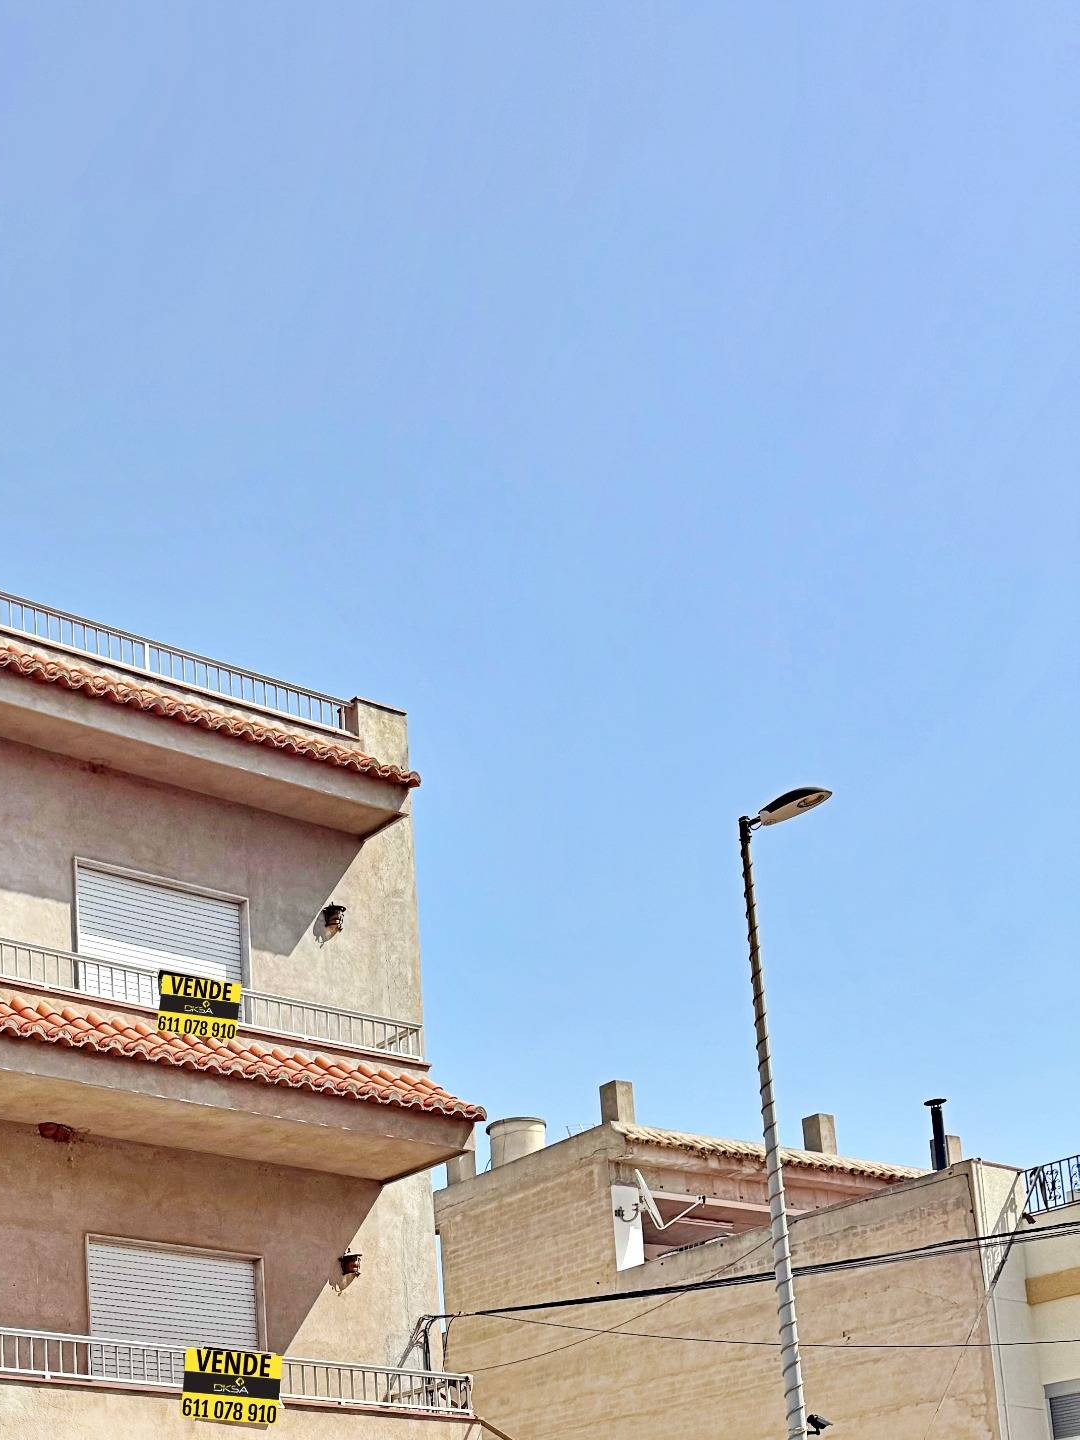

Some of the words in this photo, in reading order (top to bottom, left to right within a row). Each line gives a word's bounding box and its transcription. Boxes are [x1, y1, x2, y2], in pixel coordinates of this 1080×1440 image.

[171, 975, 232, 1001] VENDE
[158, 1015, 180, 1033] 611
[184, 1018, 207, 1036] 078
[211, 1022, 235, 1039] 910
[196, 1348, 271, 1377] VENDE
[213, 1383, 248, 1394] DKSA
[182, 1397, 208, 1418] 611
[213, 1400, 243, 1420] 078
[247, 1403, 277, 1424] 910
